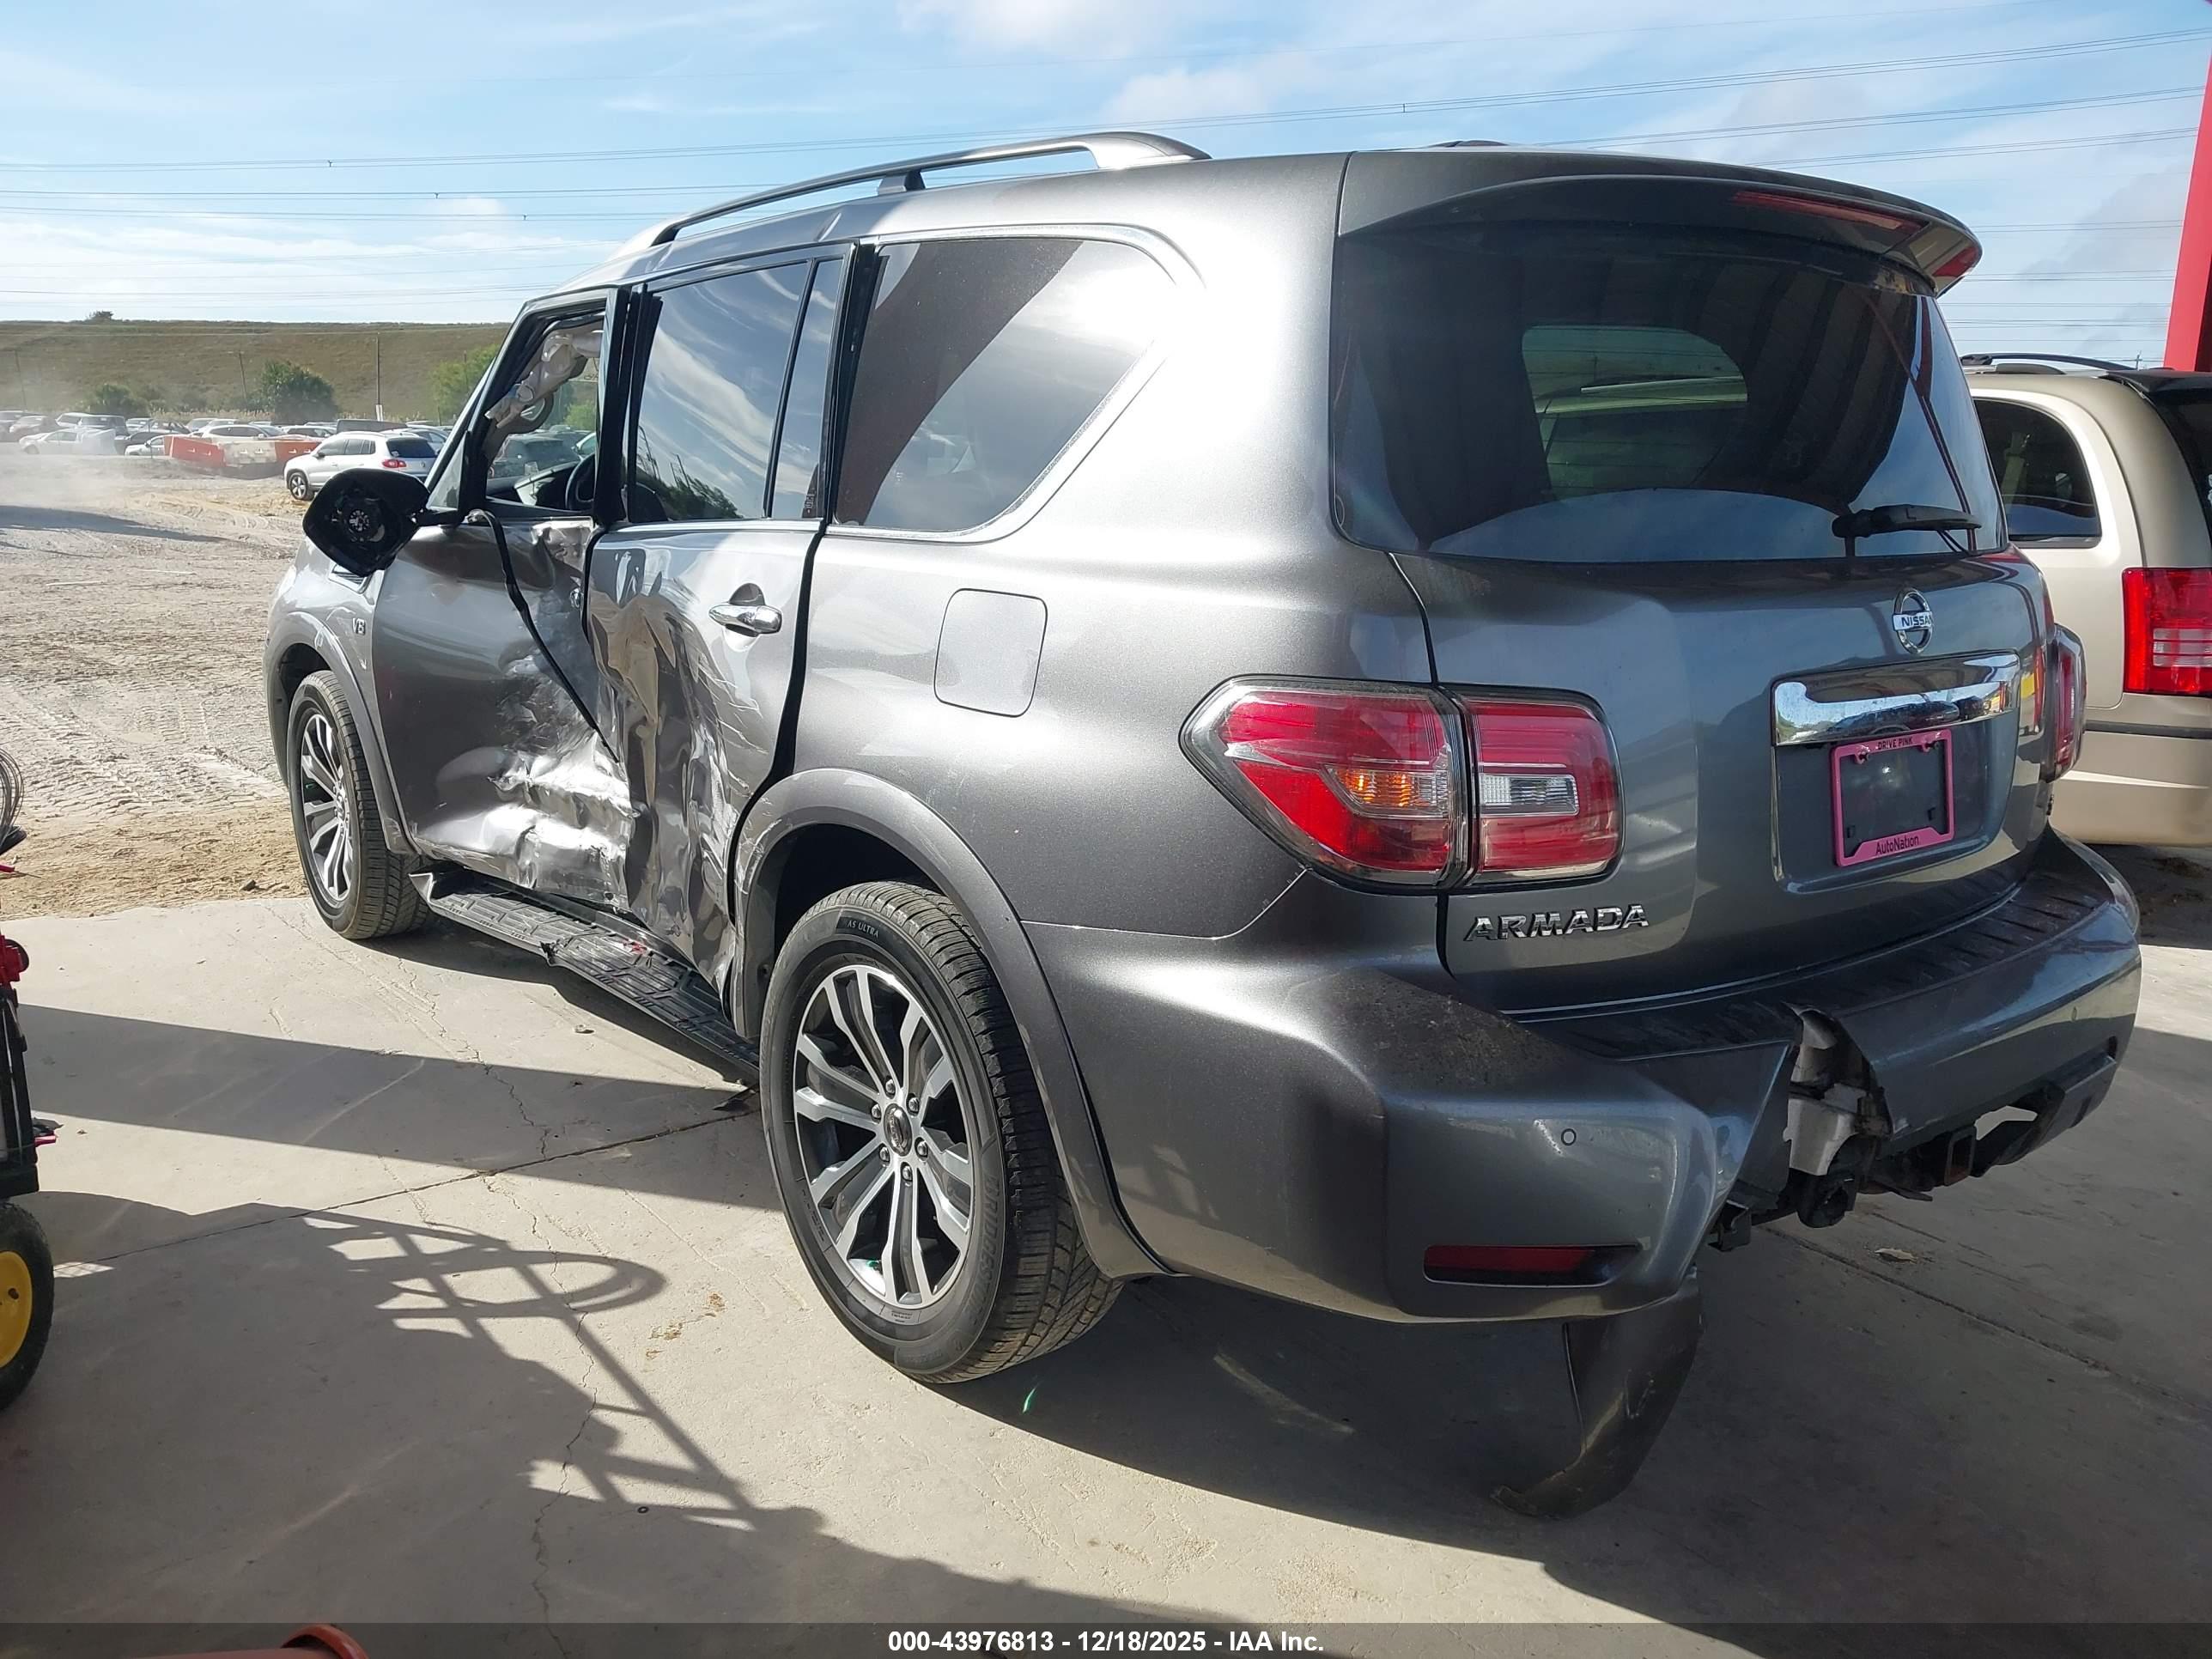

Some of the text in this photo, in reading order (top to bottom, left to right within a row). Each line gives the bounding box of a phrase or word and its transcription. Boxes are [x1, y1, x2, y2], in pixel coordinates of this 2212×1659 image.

[1877, 738, 1913, 750] DRIVE PINK
[1875, 836, 1919, 855] AutoNation
[847, 920, 880, 939] AS ULTRA
[1463, 903, 1650, 942] ARMADA
